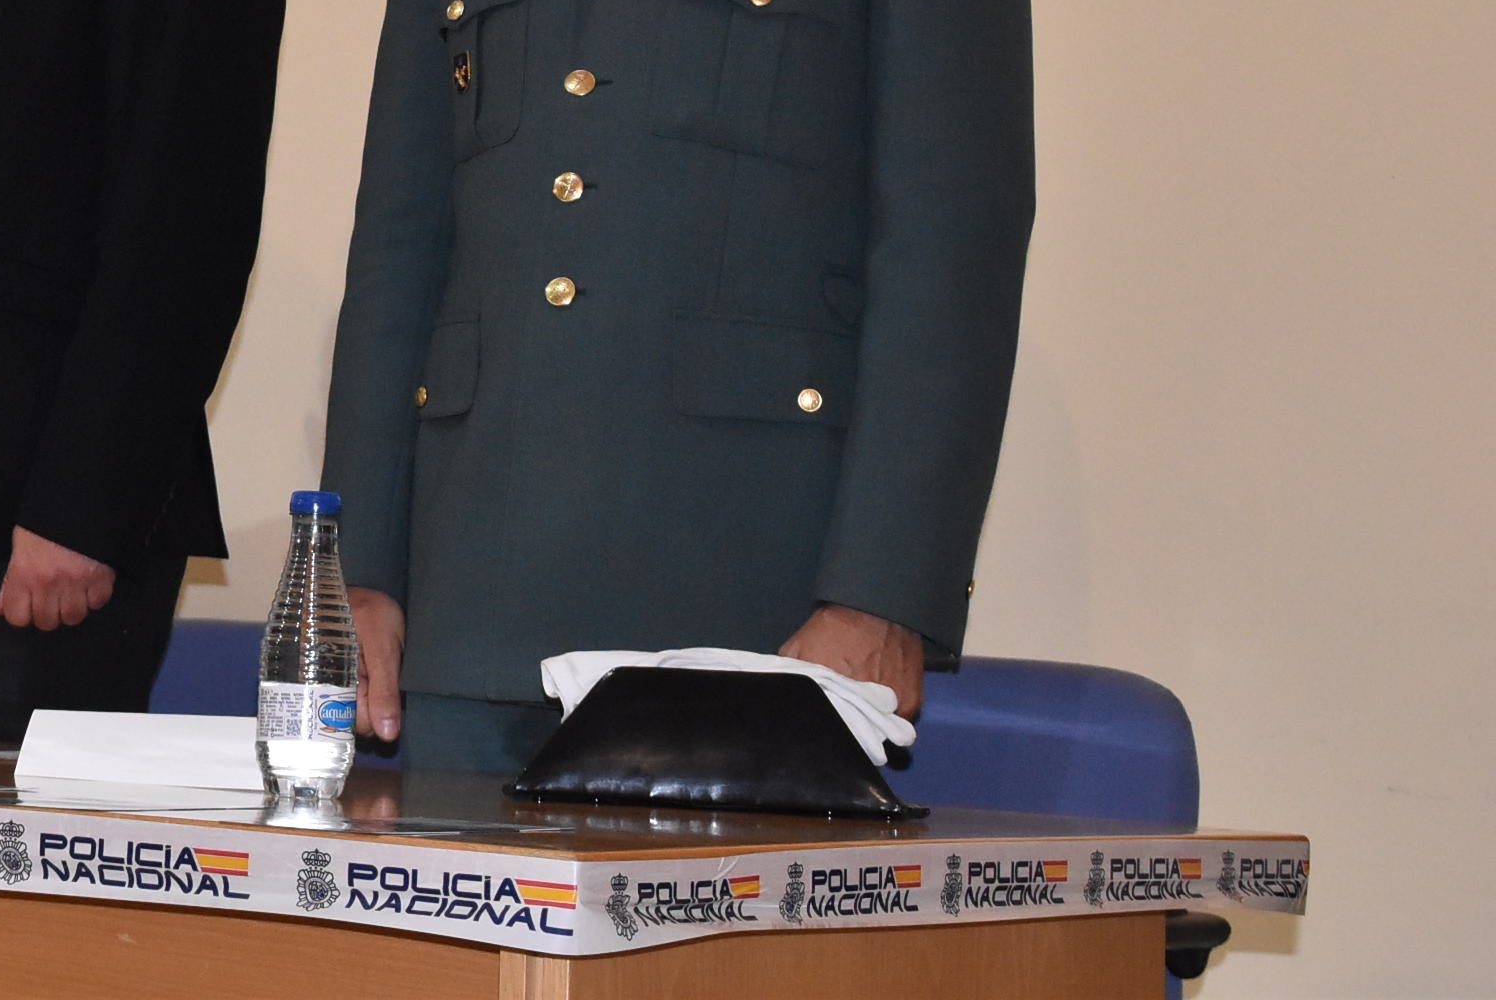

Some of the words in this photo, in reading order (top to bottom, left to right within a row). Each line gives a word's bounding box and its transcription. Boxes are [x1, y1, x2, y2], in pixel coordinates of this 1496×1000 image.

[40, 858, 250, 899] NACIONAL
[1106, 880, 1203, 901] NACIONAL
[806, 889, 919, 919] NACIONAL
[965, 884, 1064, 909] NACIONAL
[345, 888, 574, 936] NACIONAL
[633, 900, 759, 927] NACIONAL
